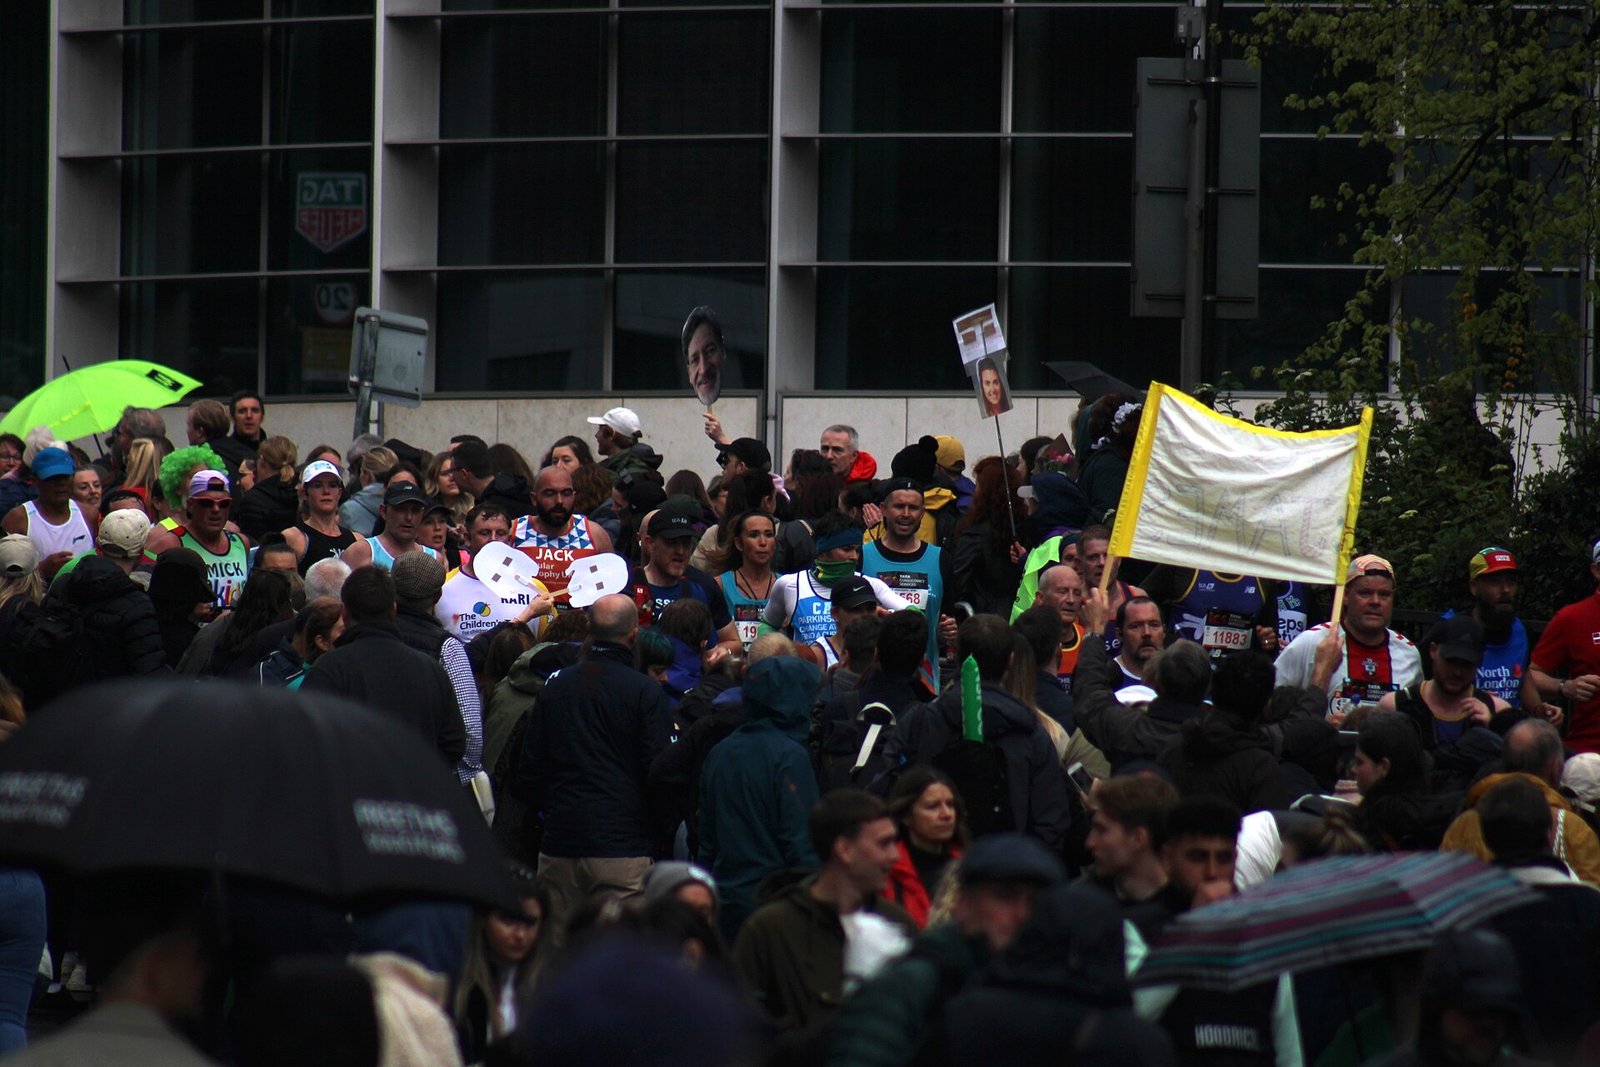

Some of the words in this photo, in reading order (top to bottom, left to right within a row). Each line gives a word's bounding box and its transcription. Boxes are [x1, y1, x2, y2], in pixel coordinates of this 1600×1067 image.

[535, 548, 575, 561] JACK
[207, 562, 244, 578] MICK
[459, 613, 477, 622] The
[1212, 630, 1248, 647] 11883
[1475, 665, 1511, 679] North
[1475, 677, 1520, 690] London
